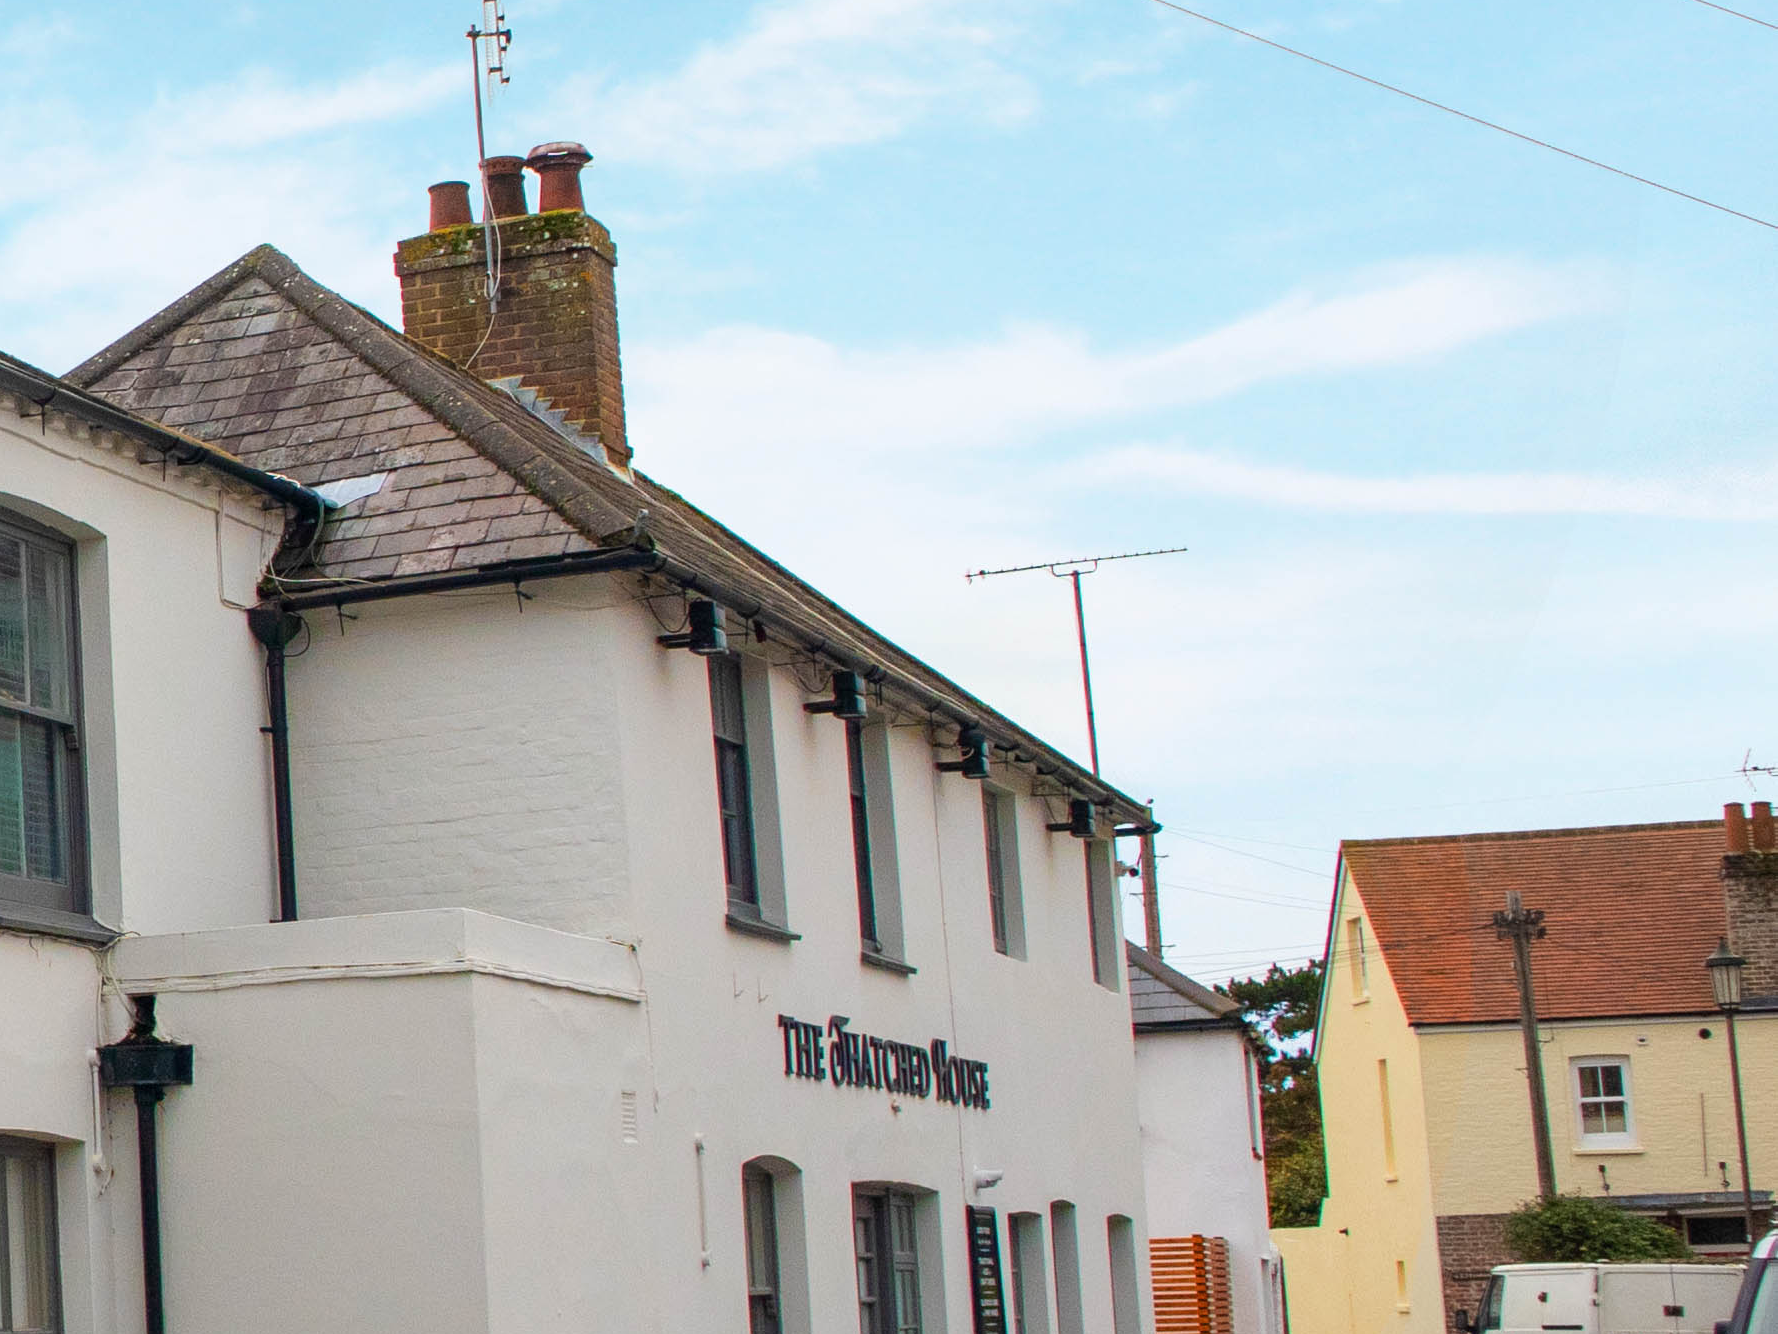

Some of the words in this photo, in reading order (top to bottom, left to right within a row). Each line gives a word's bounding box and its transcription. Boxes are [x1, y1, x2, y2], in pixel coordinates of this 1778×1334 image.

[778, 1014, 826, 1082] THE
[828, 1014, 931, 1099] THATCHED
[931, 1038, 992, 1110] HOUSE
